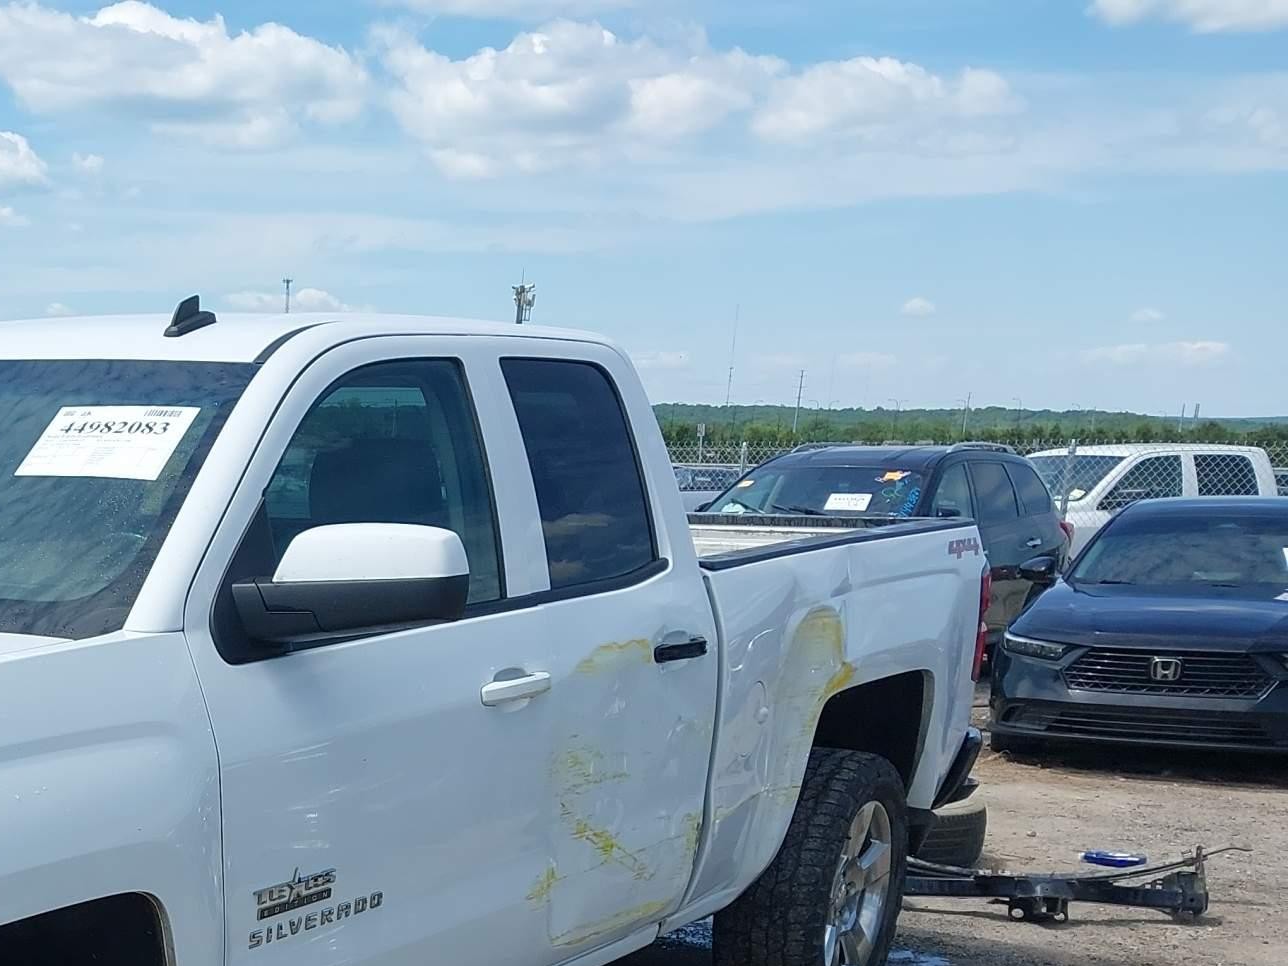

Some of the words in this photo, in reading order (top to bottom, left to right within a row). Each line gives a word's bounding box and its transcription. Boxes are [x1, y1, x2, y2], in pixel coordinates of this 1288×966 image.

[60, 420, 171, 435] 44982083
[261, 890, 329, 917] EDITION
[248, 890, 384, 950] SILVERADO
